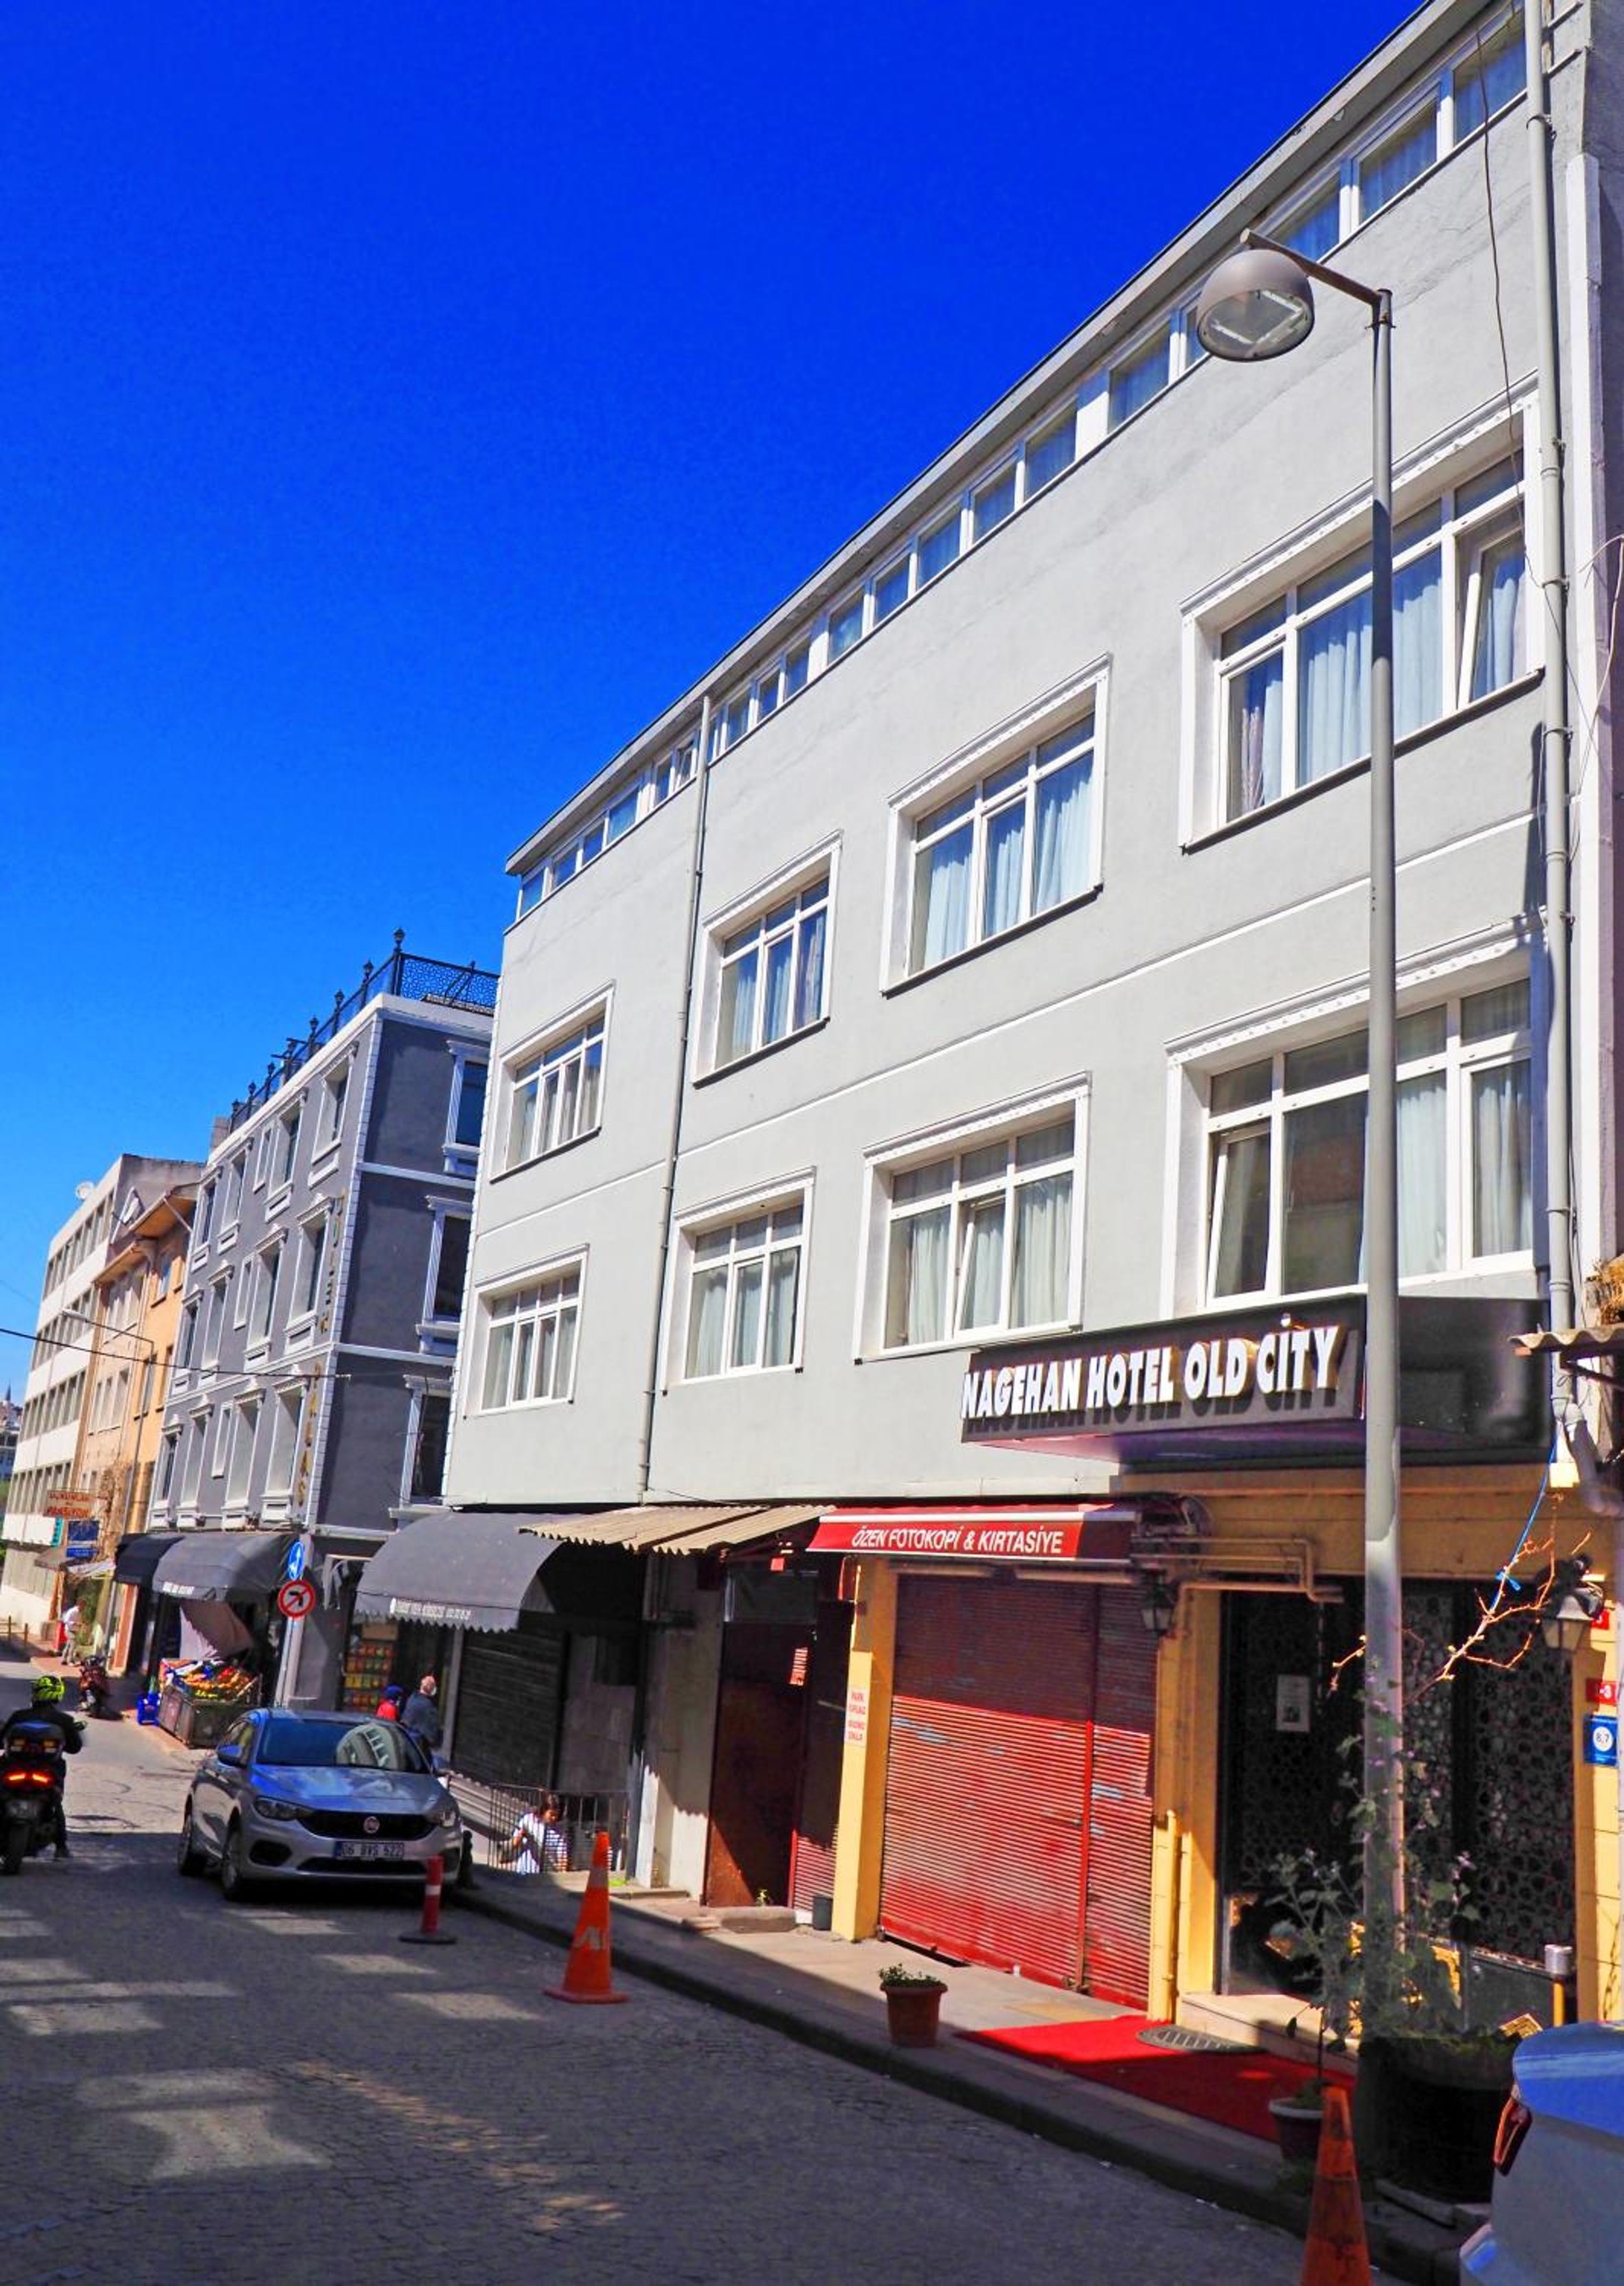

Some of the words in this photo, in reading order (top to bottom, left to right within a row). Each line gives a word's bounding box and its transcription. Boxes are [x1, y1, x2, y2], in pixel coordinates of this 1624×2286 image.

[961, 1358, 1082, 1419] NAGEHAN
[1086, 1346, 1174, 1409] HOTEL
[1184, 1337, 1248, 1400] OLD
[852, 1525, 888, 1547] ÖZEN
[888, 1525, 964, 1550] FOTOKOPİ
[963, 1530, 975, 1551] &
[977, 1525, 1065, 1553] KIRTASİYE
